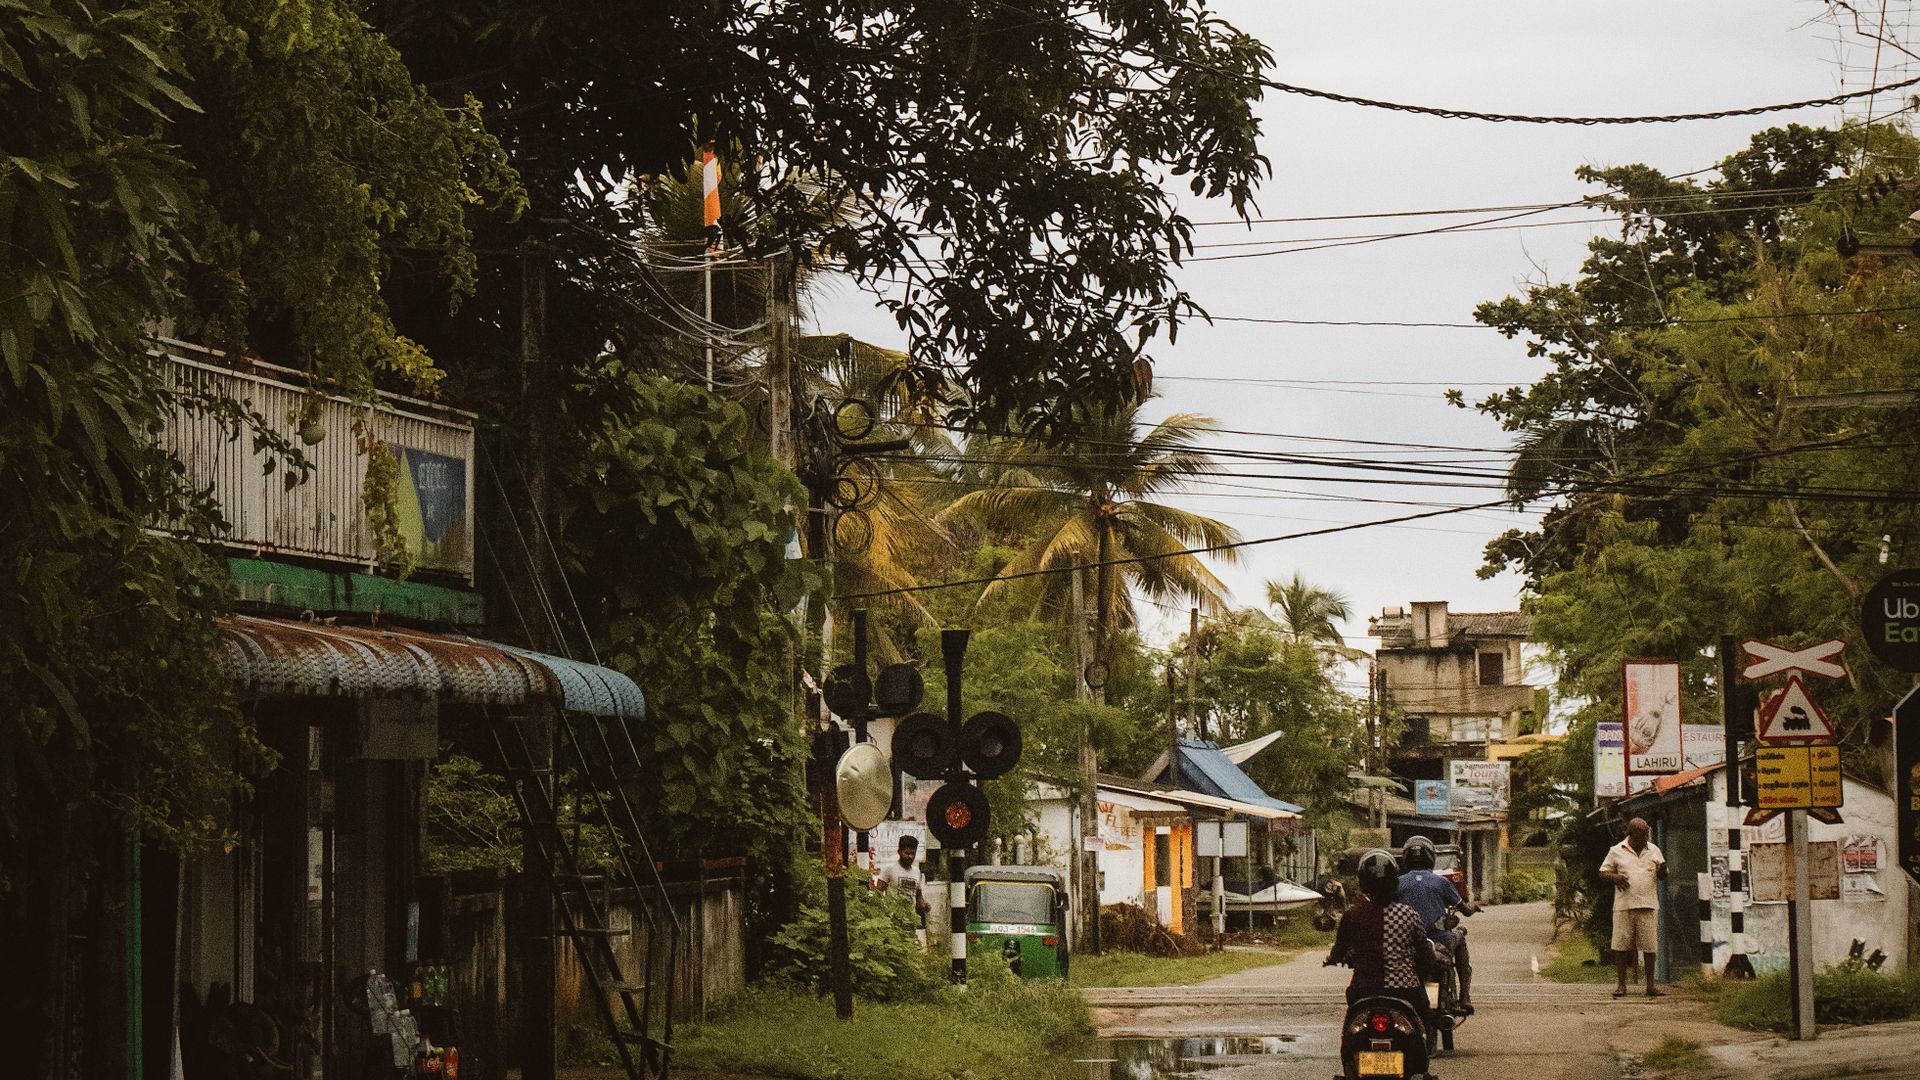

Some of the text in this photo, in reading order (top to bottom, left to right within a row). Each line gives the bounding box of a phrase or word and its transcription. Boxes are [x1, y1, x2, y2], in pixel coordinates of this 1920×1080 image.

[1884, 622, 1920, 643] Ea
[1598, 730, 1624, 741] DAN
[1684, 732, 1725, 742] ESTAUR
[1637, 757, 1677, 769] LAHIRU
[1469, 769, 1499, 778] Tours
